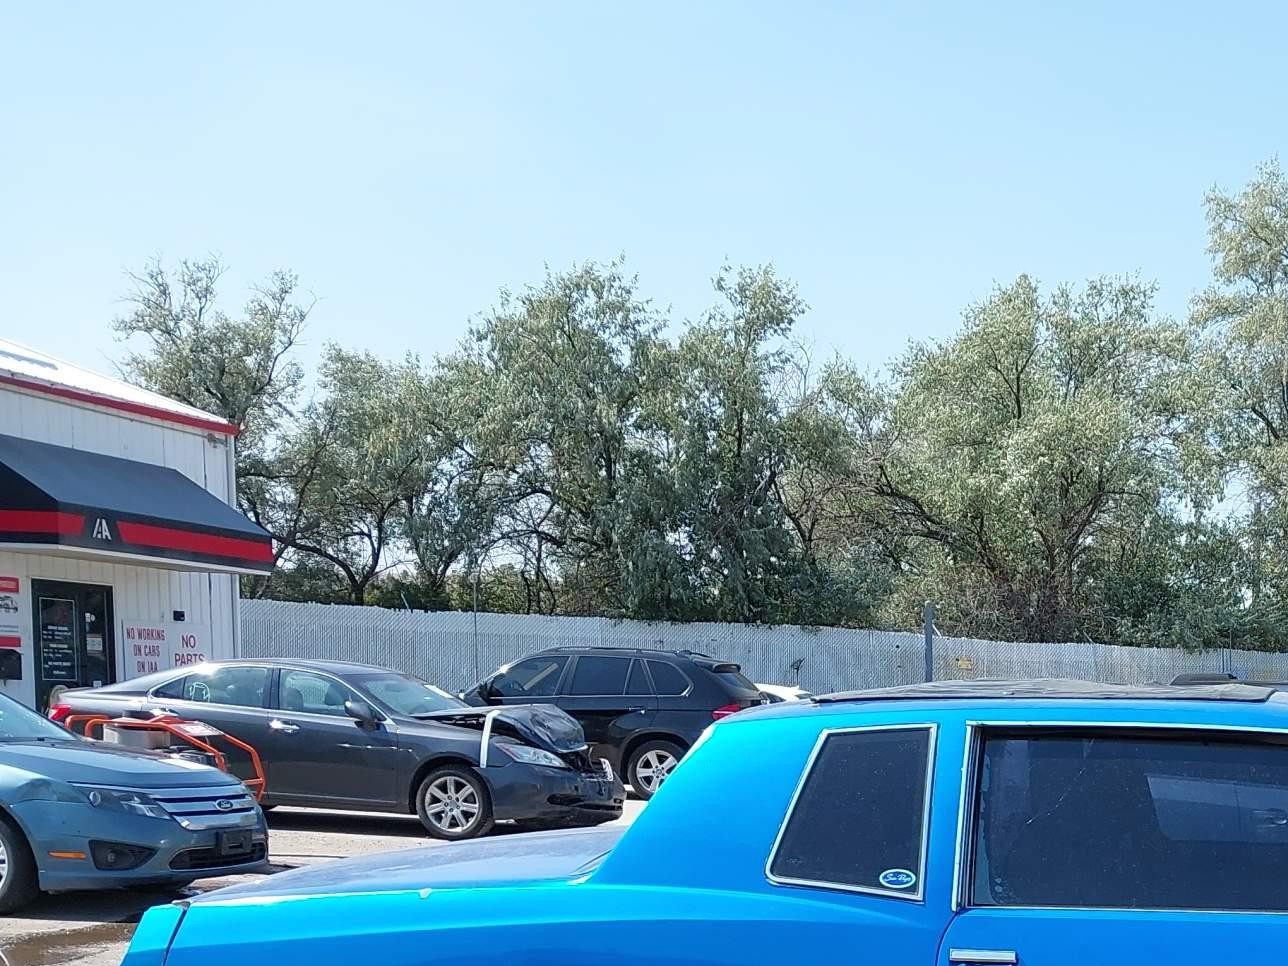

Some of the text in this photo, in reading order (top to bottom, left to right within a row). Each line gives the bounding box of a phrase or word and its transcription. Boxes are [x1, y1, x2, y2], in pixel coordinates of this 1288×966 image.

[126, 627, 166, 641] NO WORKING
[181, 634, 197, 649] NO
[133, 644, 161, 658] ON CARS
[136, 660, 146, 673] ON
[174, 653, 205, 667] PARTS
